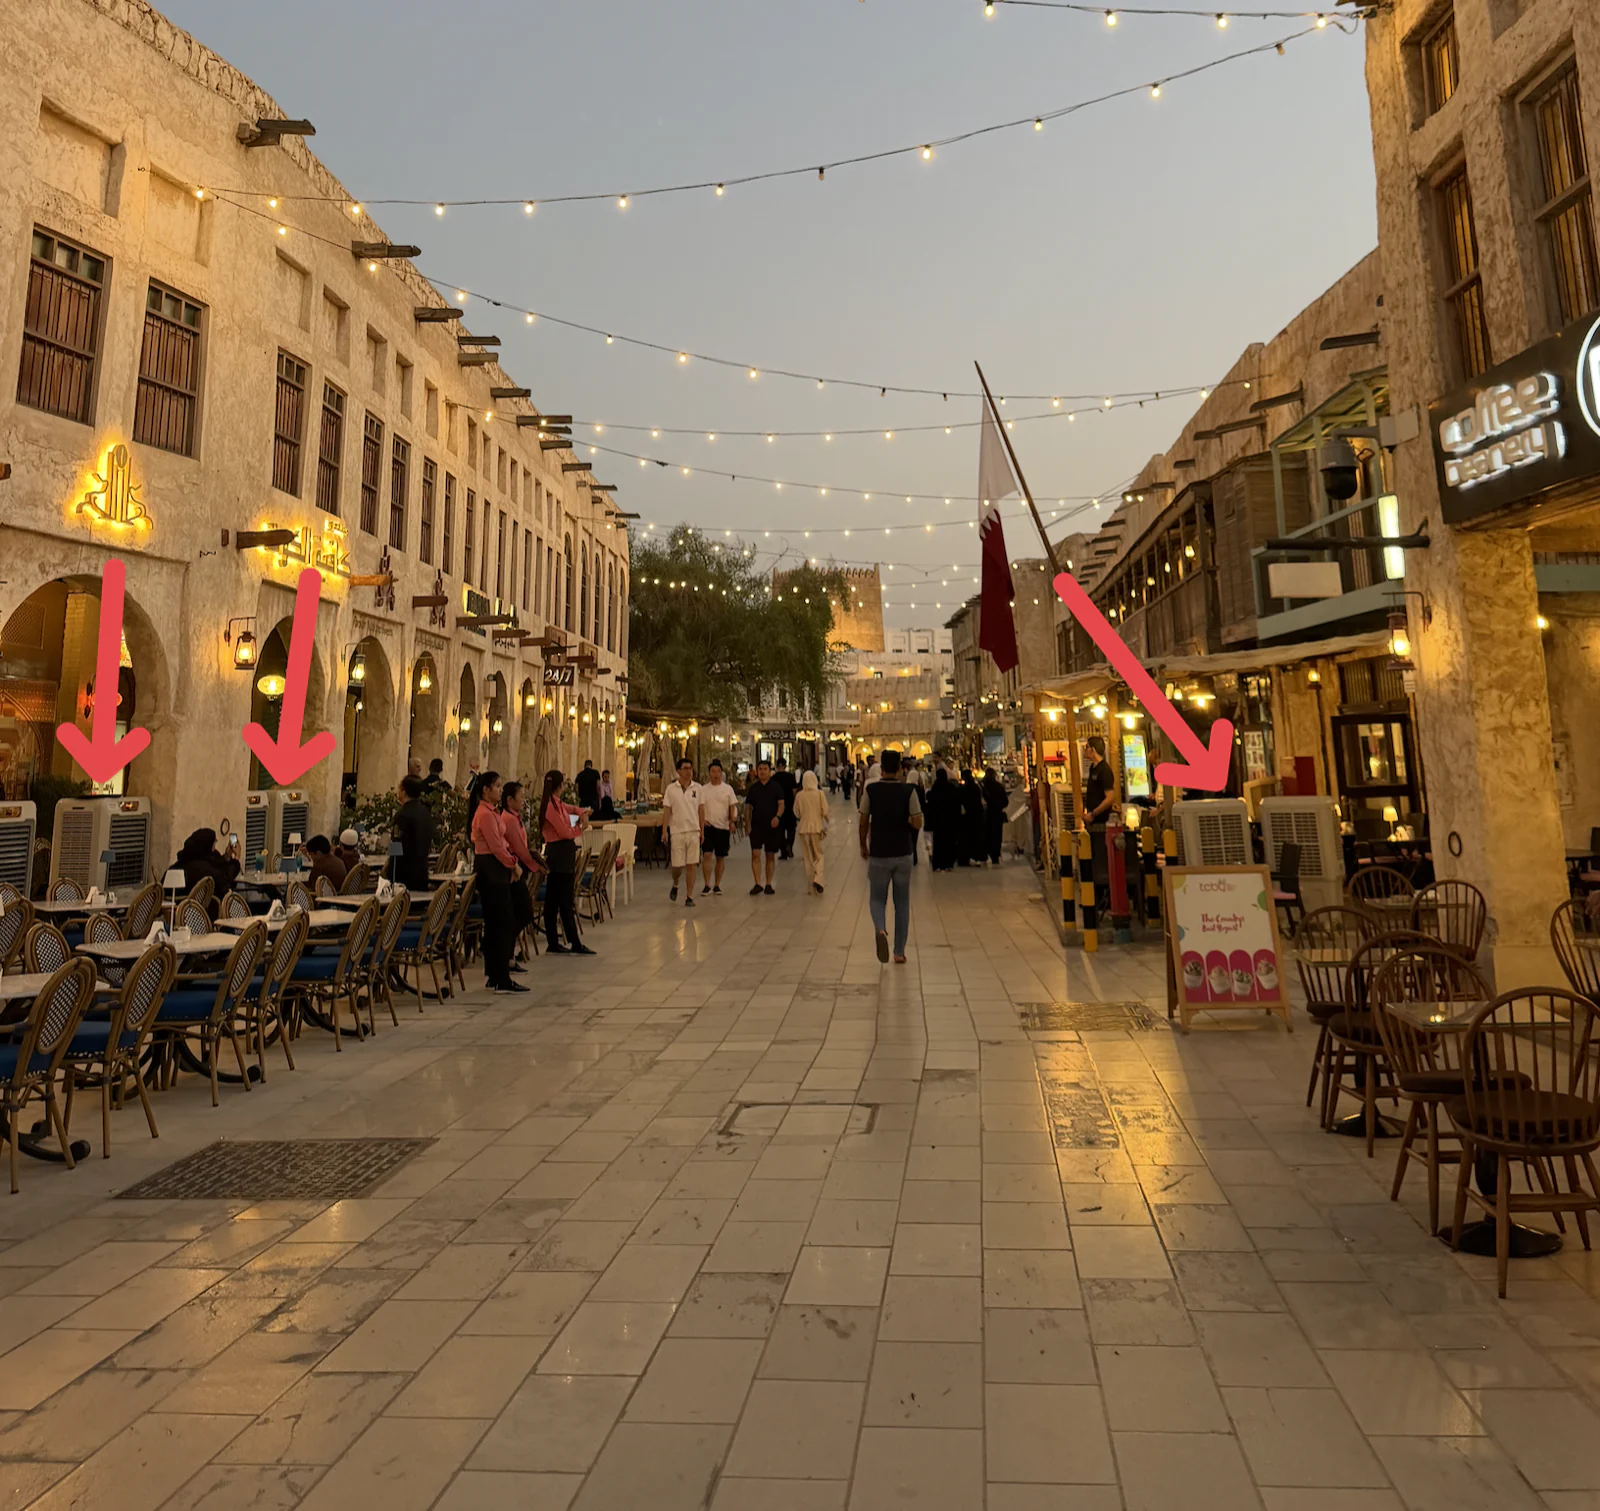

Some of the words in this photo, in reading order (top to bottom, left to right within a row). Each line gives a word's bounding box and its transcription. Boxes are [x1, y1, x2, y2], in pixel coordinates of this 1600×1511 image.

[545, 667, 572, 685] 24/7
[1043, 724, 1068, 740] RES
[1076, 722, 1107, 738] JUICE
